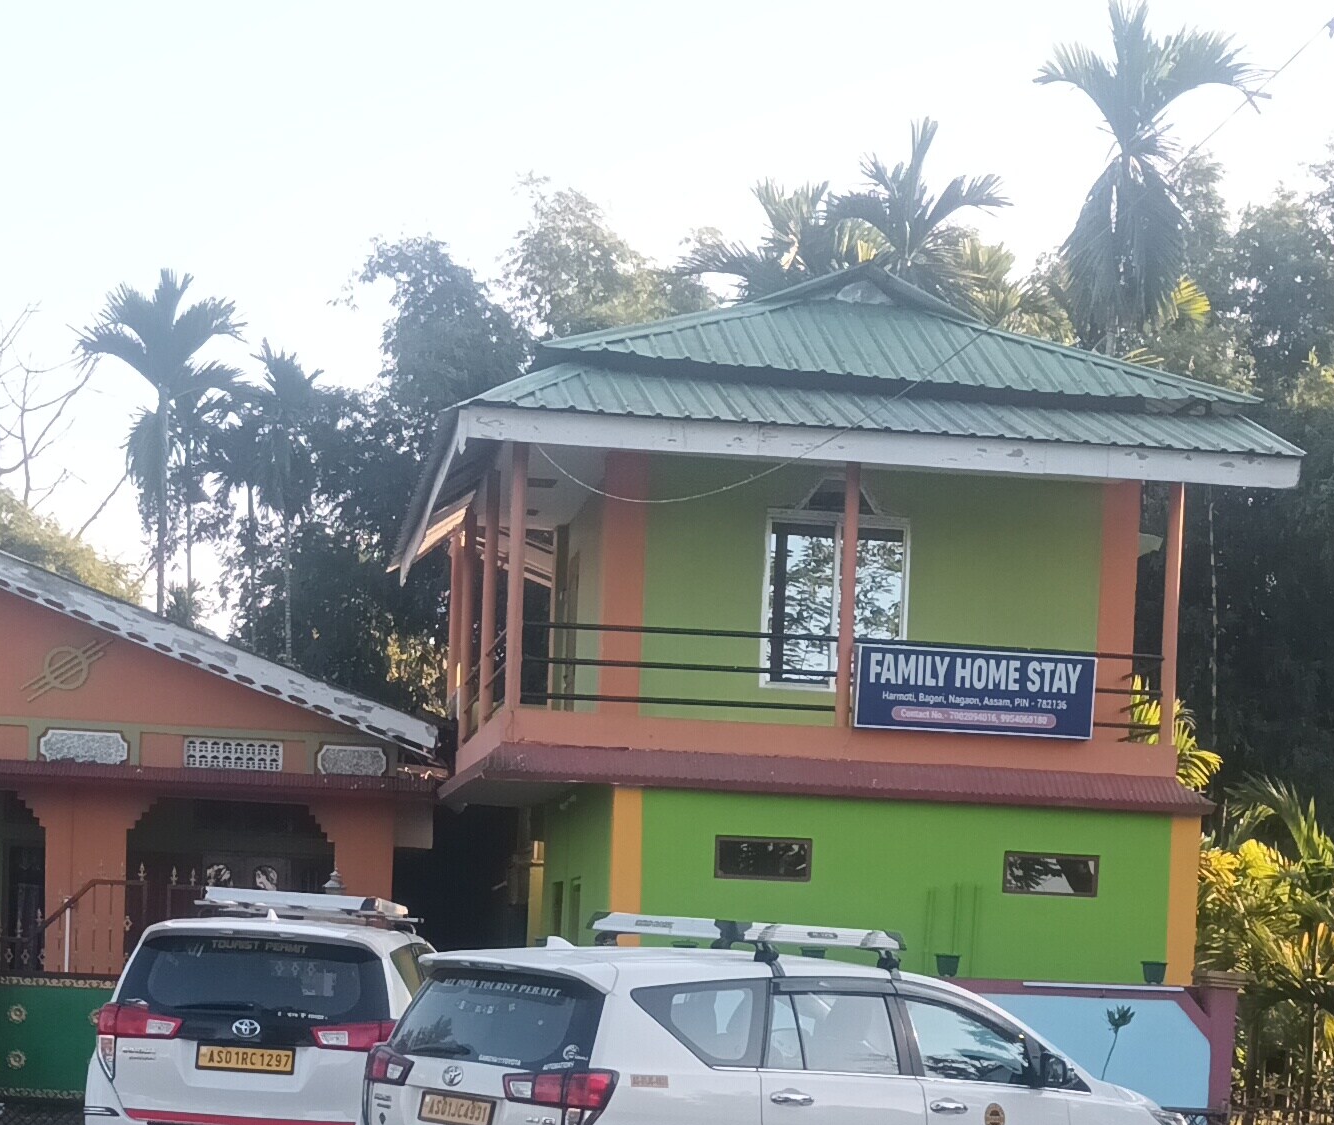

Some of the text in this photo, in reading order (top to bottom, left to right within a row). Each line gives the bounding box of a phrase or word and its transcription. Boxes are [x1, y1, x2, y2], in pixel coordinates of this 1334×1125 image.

[869, 653, 1082, 694] FAMILY HOME STAY
[948, 695, 981, 706] Nagaon,
[983, 697, 1012, 708] Assam,
[1014, 698, 1029, 707] PIN
[900, 709, 929, 718] Contact
[478, 981, 518, 991] TOURIST
[518, 984, 562, 998] PERMIT
[207, 1048, 290, 1068] AS01RC1297
